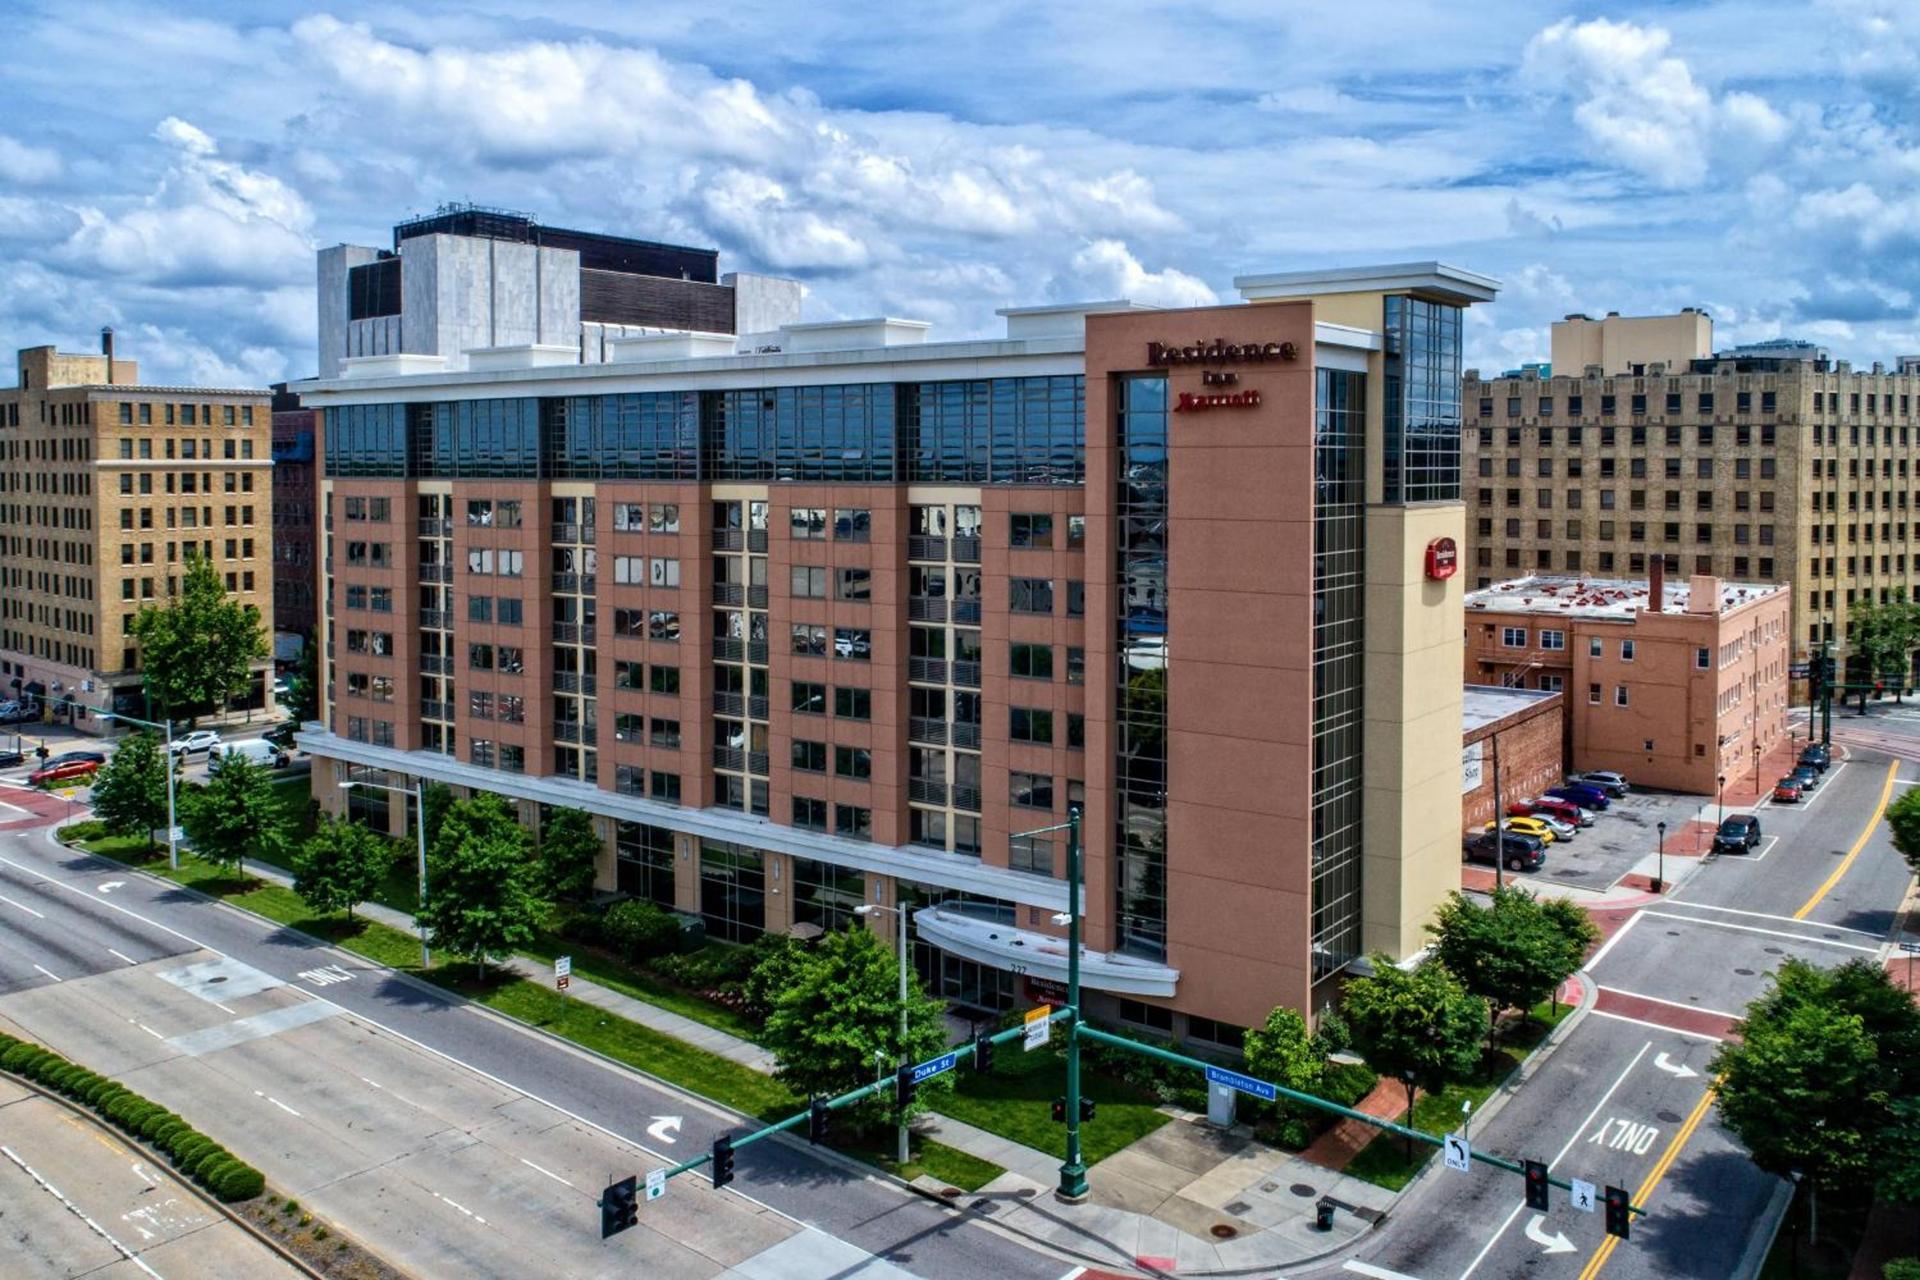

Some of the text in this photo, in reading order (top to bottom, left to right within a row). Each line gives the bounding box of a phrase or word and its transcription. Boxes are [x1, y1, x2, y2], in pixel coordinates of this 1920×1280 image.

[1147, 338, 1297, 366] Residence
[1203, 371, 1239, 387] Inn
[1174, 390, 1260, 412] Marriott
[297, 964, 358, 986] ONLY
[914, 1059, 950, 1079] Duke St
[1587, 1117, 1659, 1155] ONLY
[1447, 1158, 1467, 1169] ONLY
